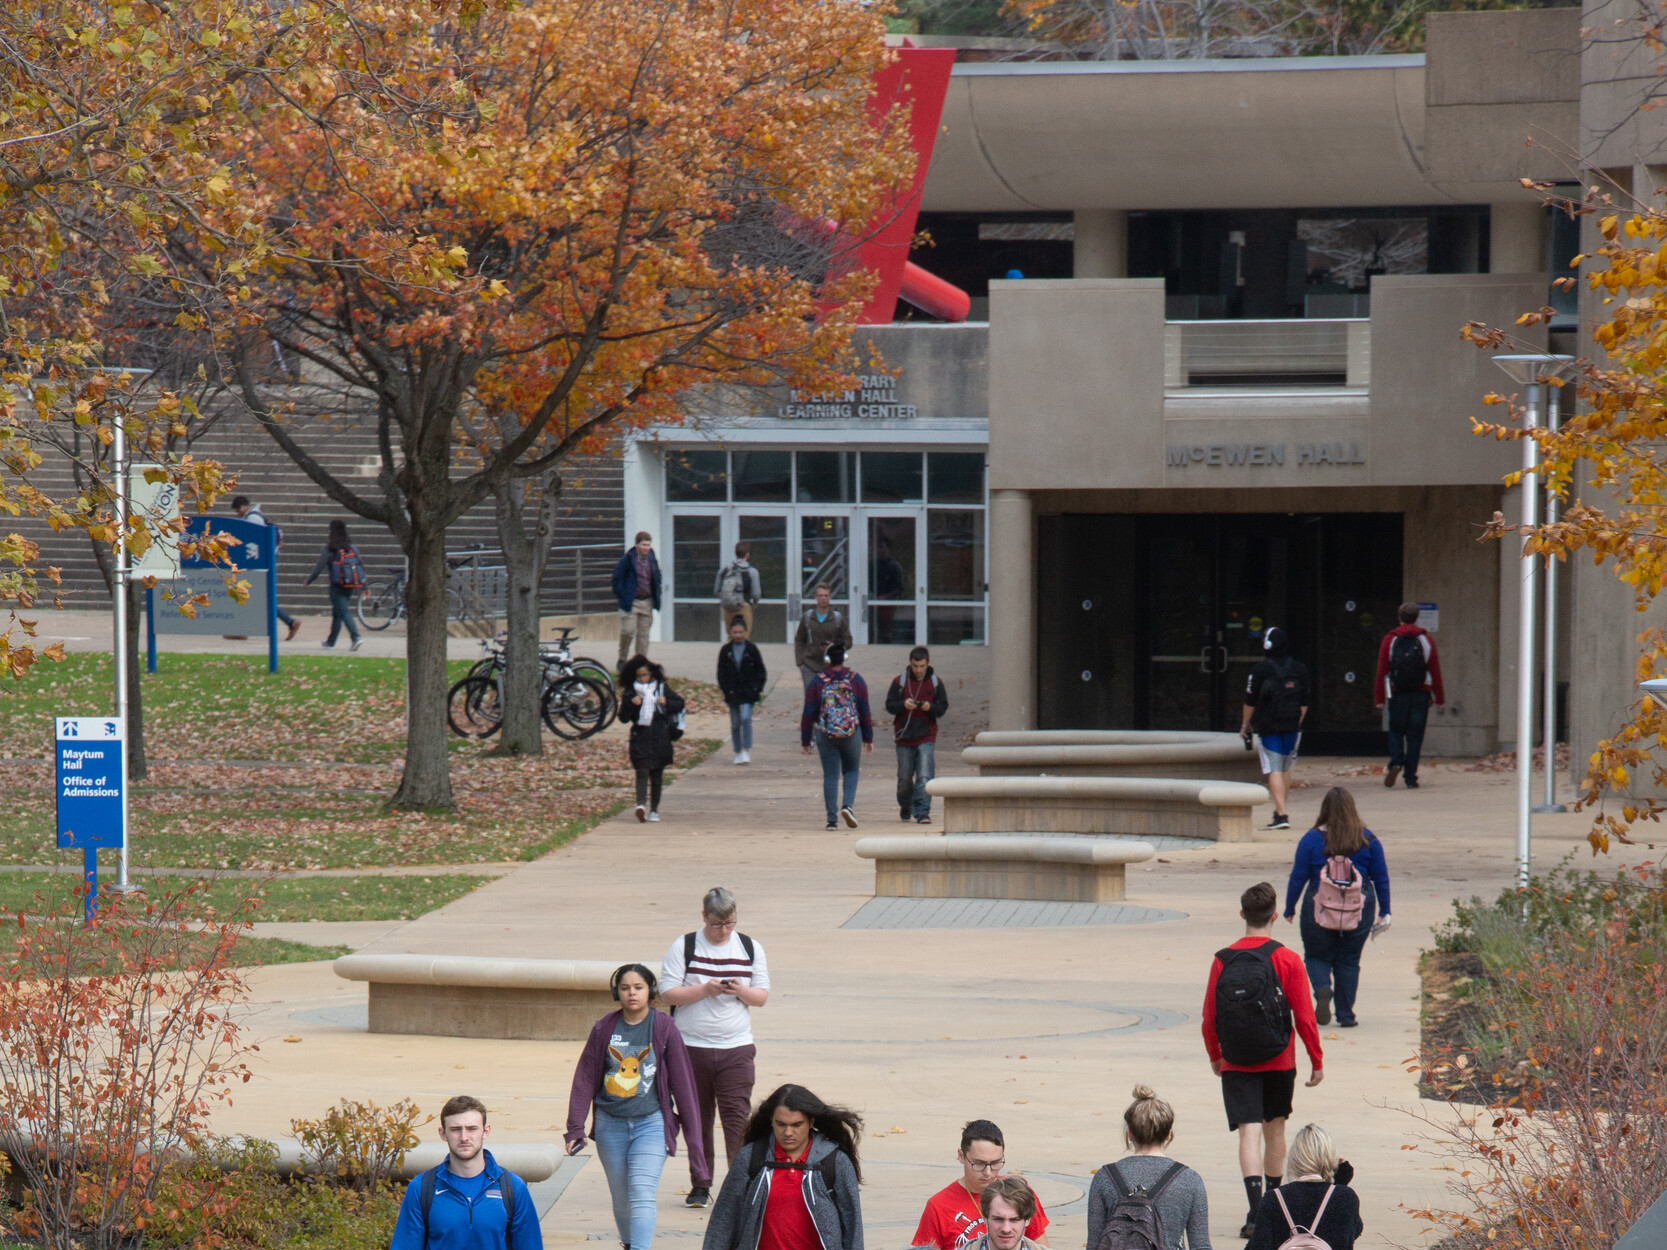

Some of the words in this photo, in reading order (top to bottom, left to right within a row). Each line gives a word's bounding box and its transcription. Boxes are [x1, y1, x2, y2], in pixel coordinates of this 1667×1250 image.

[857, 375, 897, 388] RARY
[861, 389, 898, 402] HALL
[779, 404, 851, 418] LEARNING
[858, 404, 917, 418] CENTER
[1297, 443, 1366, 466] HALL
[63, 750, 104, 760] Maytum
[63, 760, 82, 769] Hall
[63, 776, 93, 786] Office
[95, 776, 106, 786] of
[63, 787, 119, 797] Admissions
